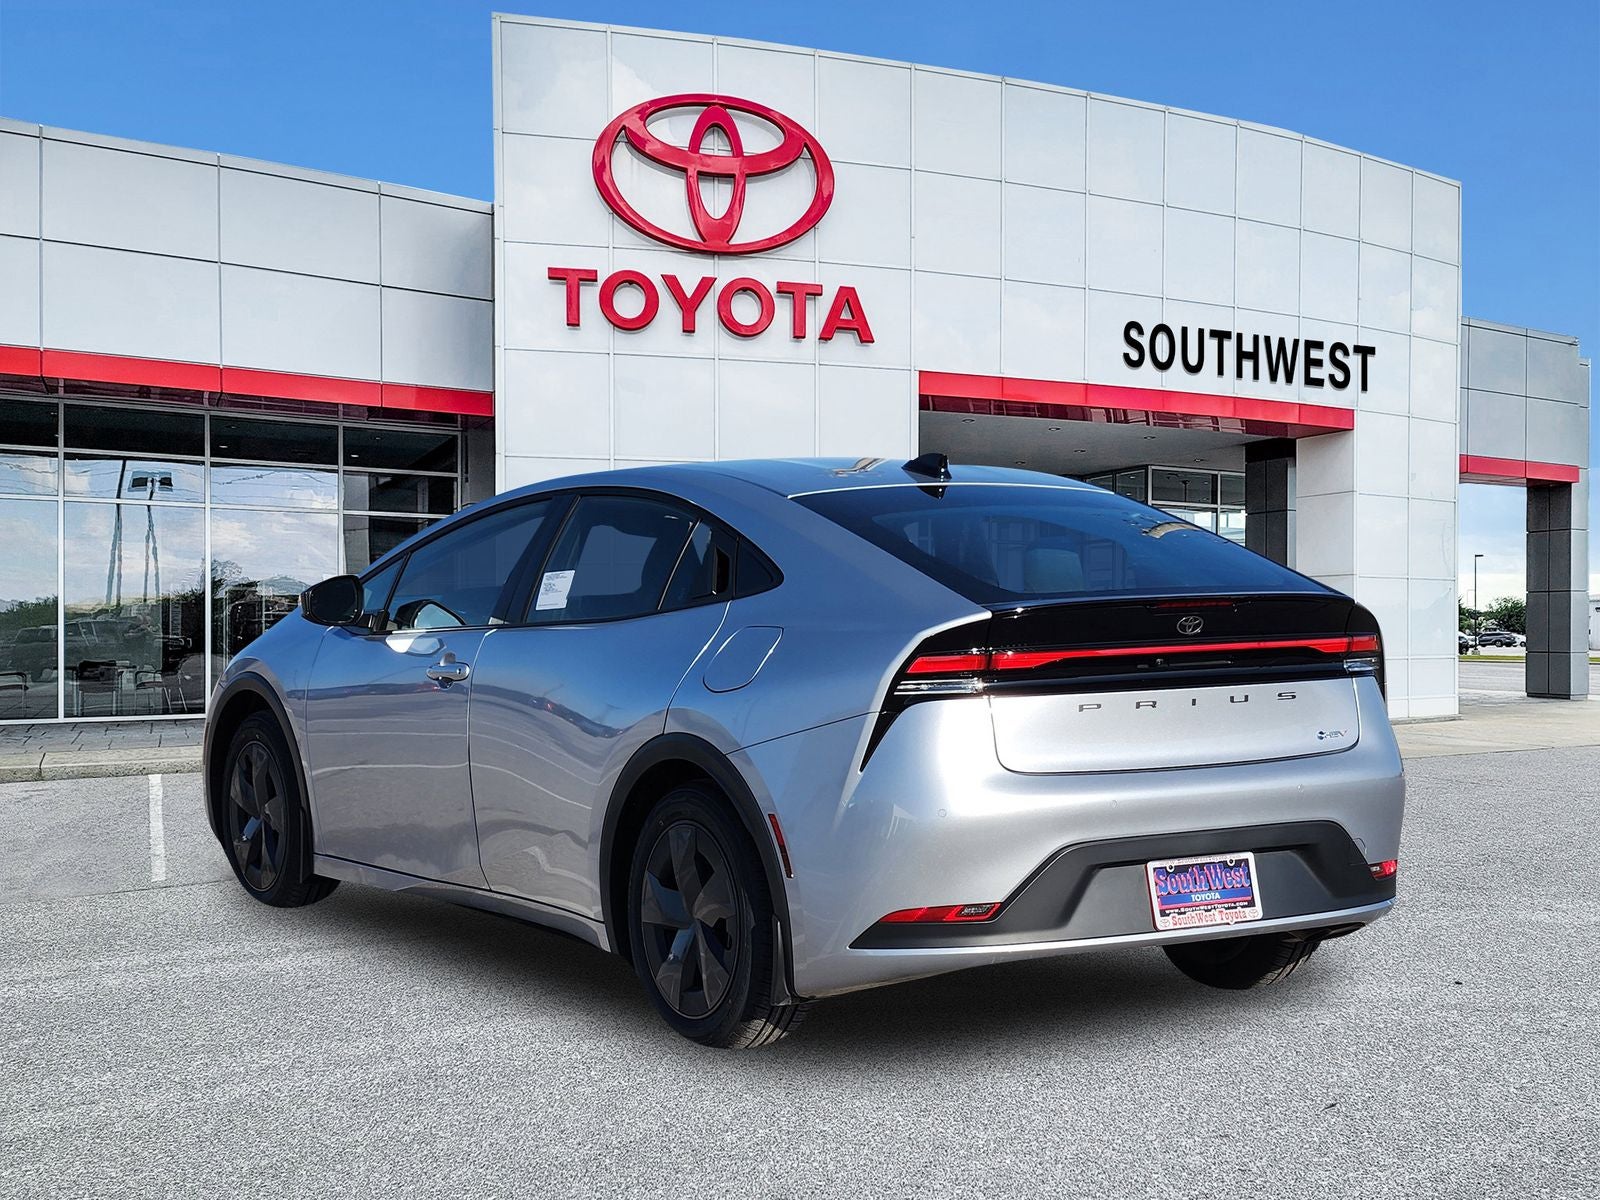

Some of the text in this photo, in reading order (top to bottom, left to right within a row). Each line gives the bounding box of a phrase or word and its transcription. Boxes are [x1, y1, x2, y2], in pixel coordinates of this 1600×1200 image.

[547, 266, 875, 344] TOYOTA
[1122, 320, 1376, 392] SOUTHWEST
[1078, 691, 1297, 712] PRIUS
[1155, 862, 1251, 895] SouthWest
[1191, 892, 1221, 902] TOYOTA
[1171, 909, 1247, 926] SouthWest Toyota
